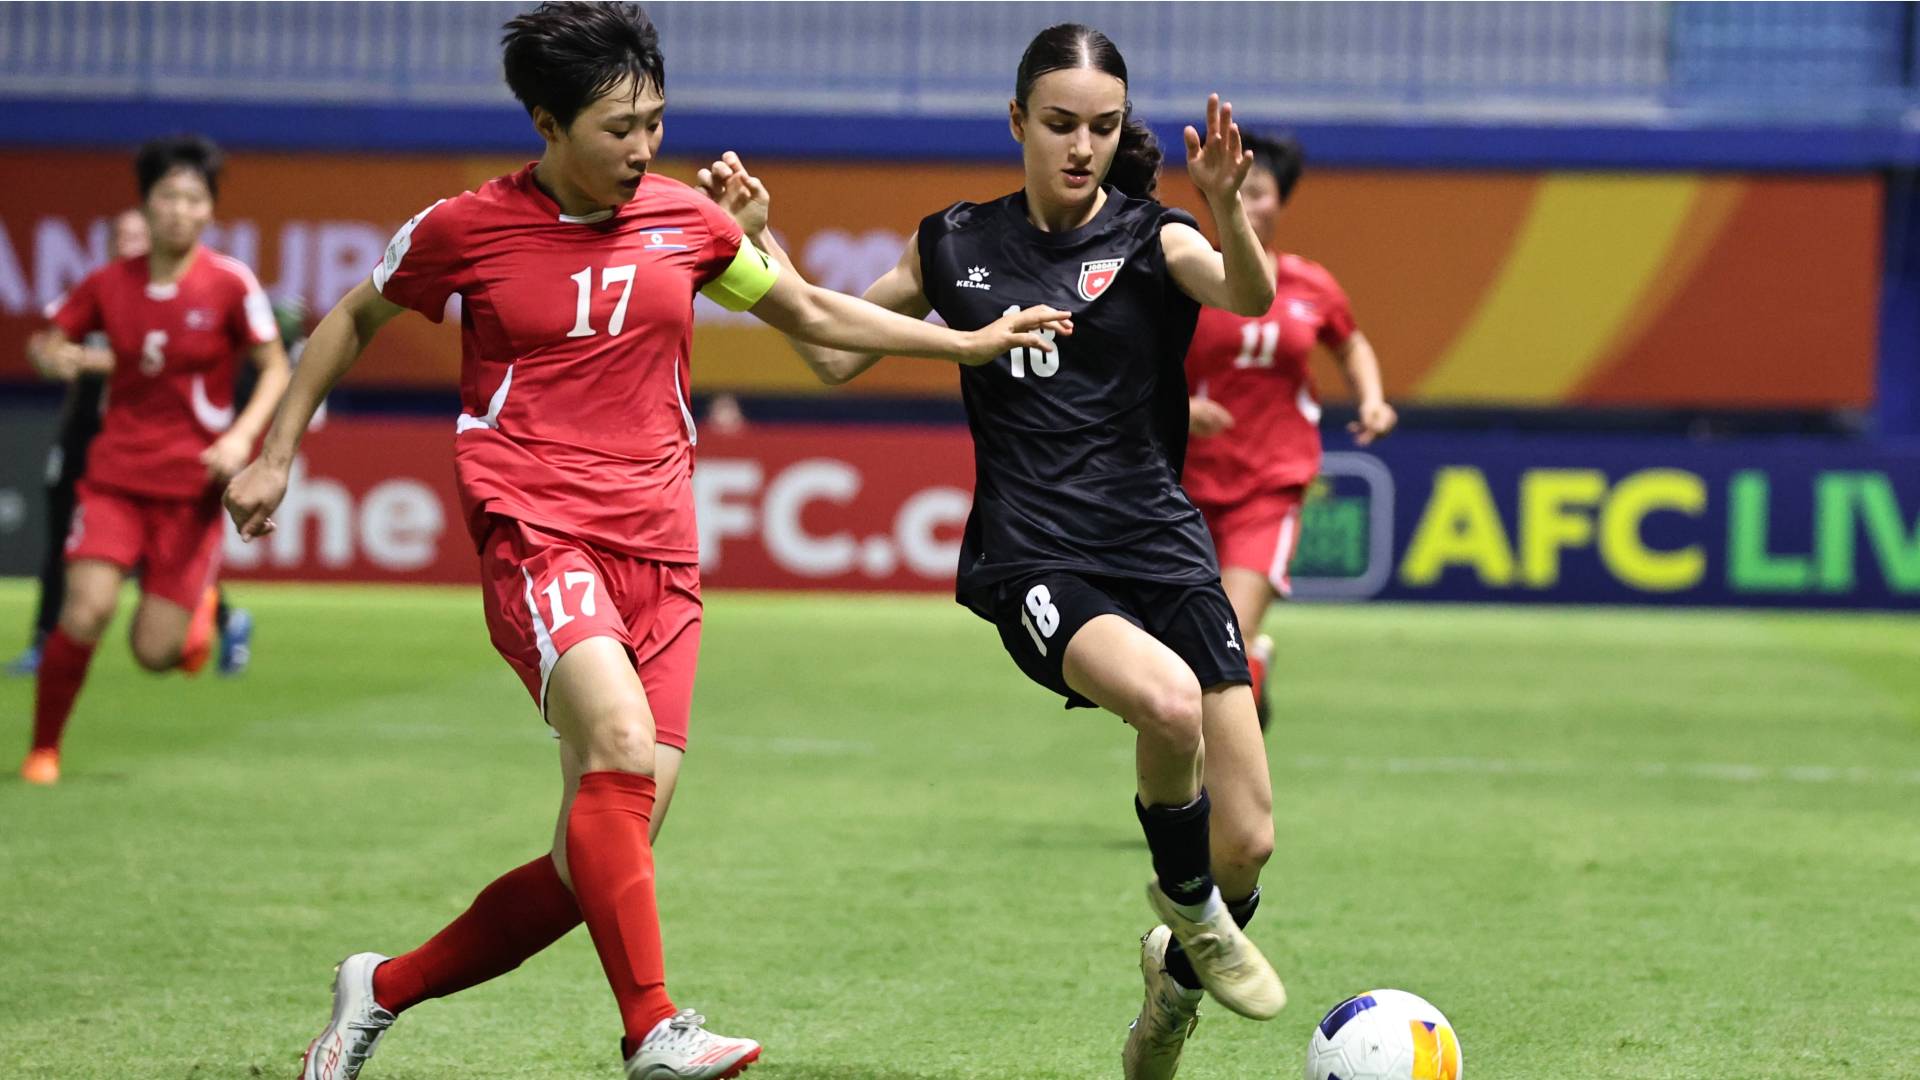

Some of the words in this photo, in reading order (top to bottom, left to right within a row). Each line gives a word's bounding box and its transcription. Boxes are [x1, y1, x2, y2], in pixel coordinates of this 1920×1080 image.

[566, 264, 637, 338] 17
[956, 279, 991, 291] KELME
[140, 329, 169, 378] 5
[1233, 320, 1280, 370] 11
[1401, 465, 1708, 591] AFC
[541, 570, 597, 635] 17
[1021, 583, 1061, 658] 18
